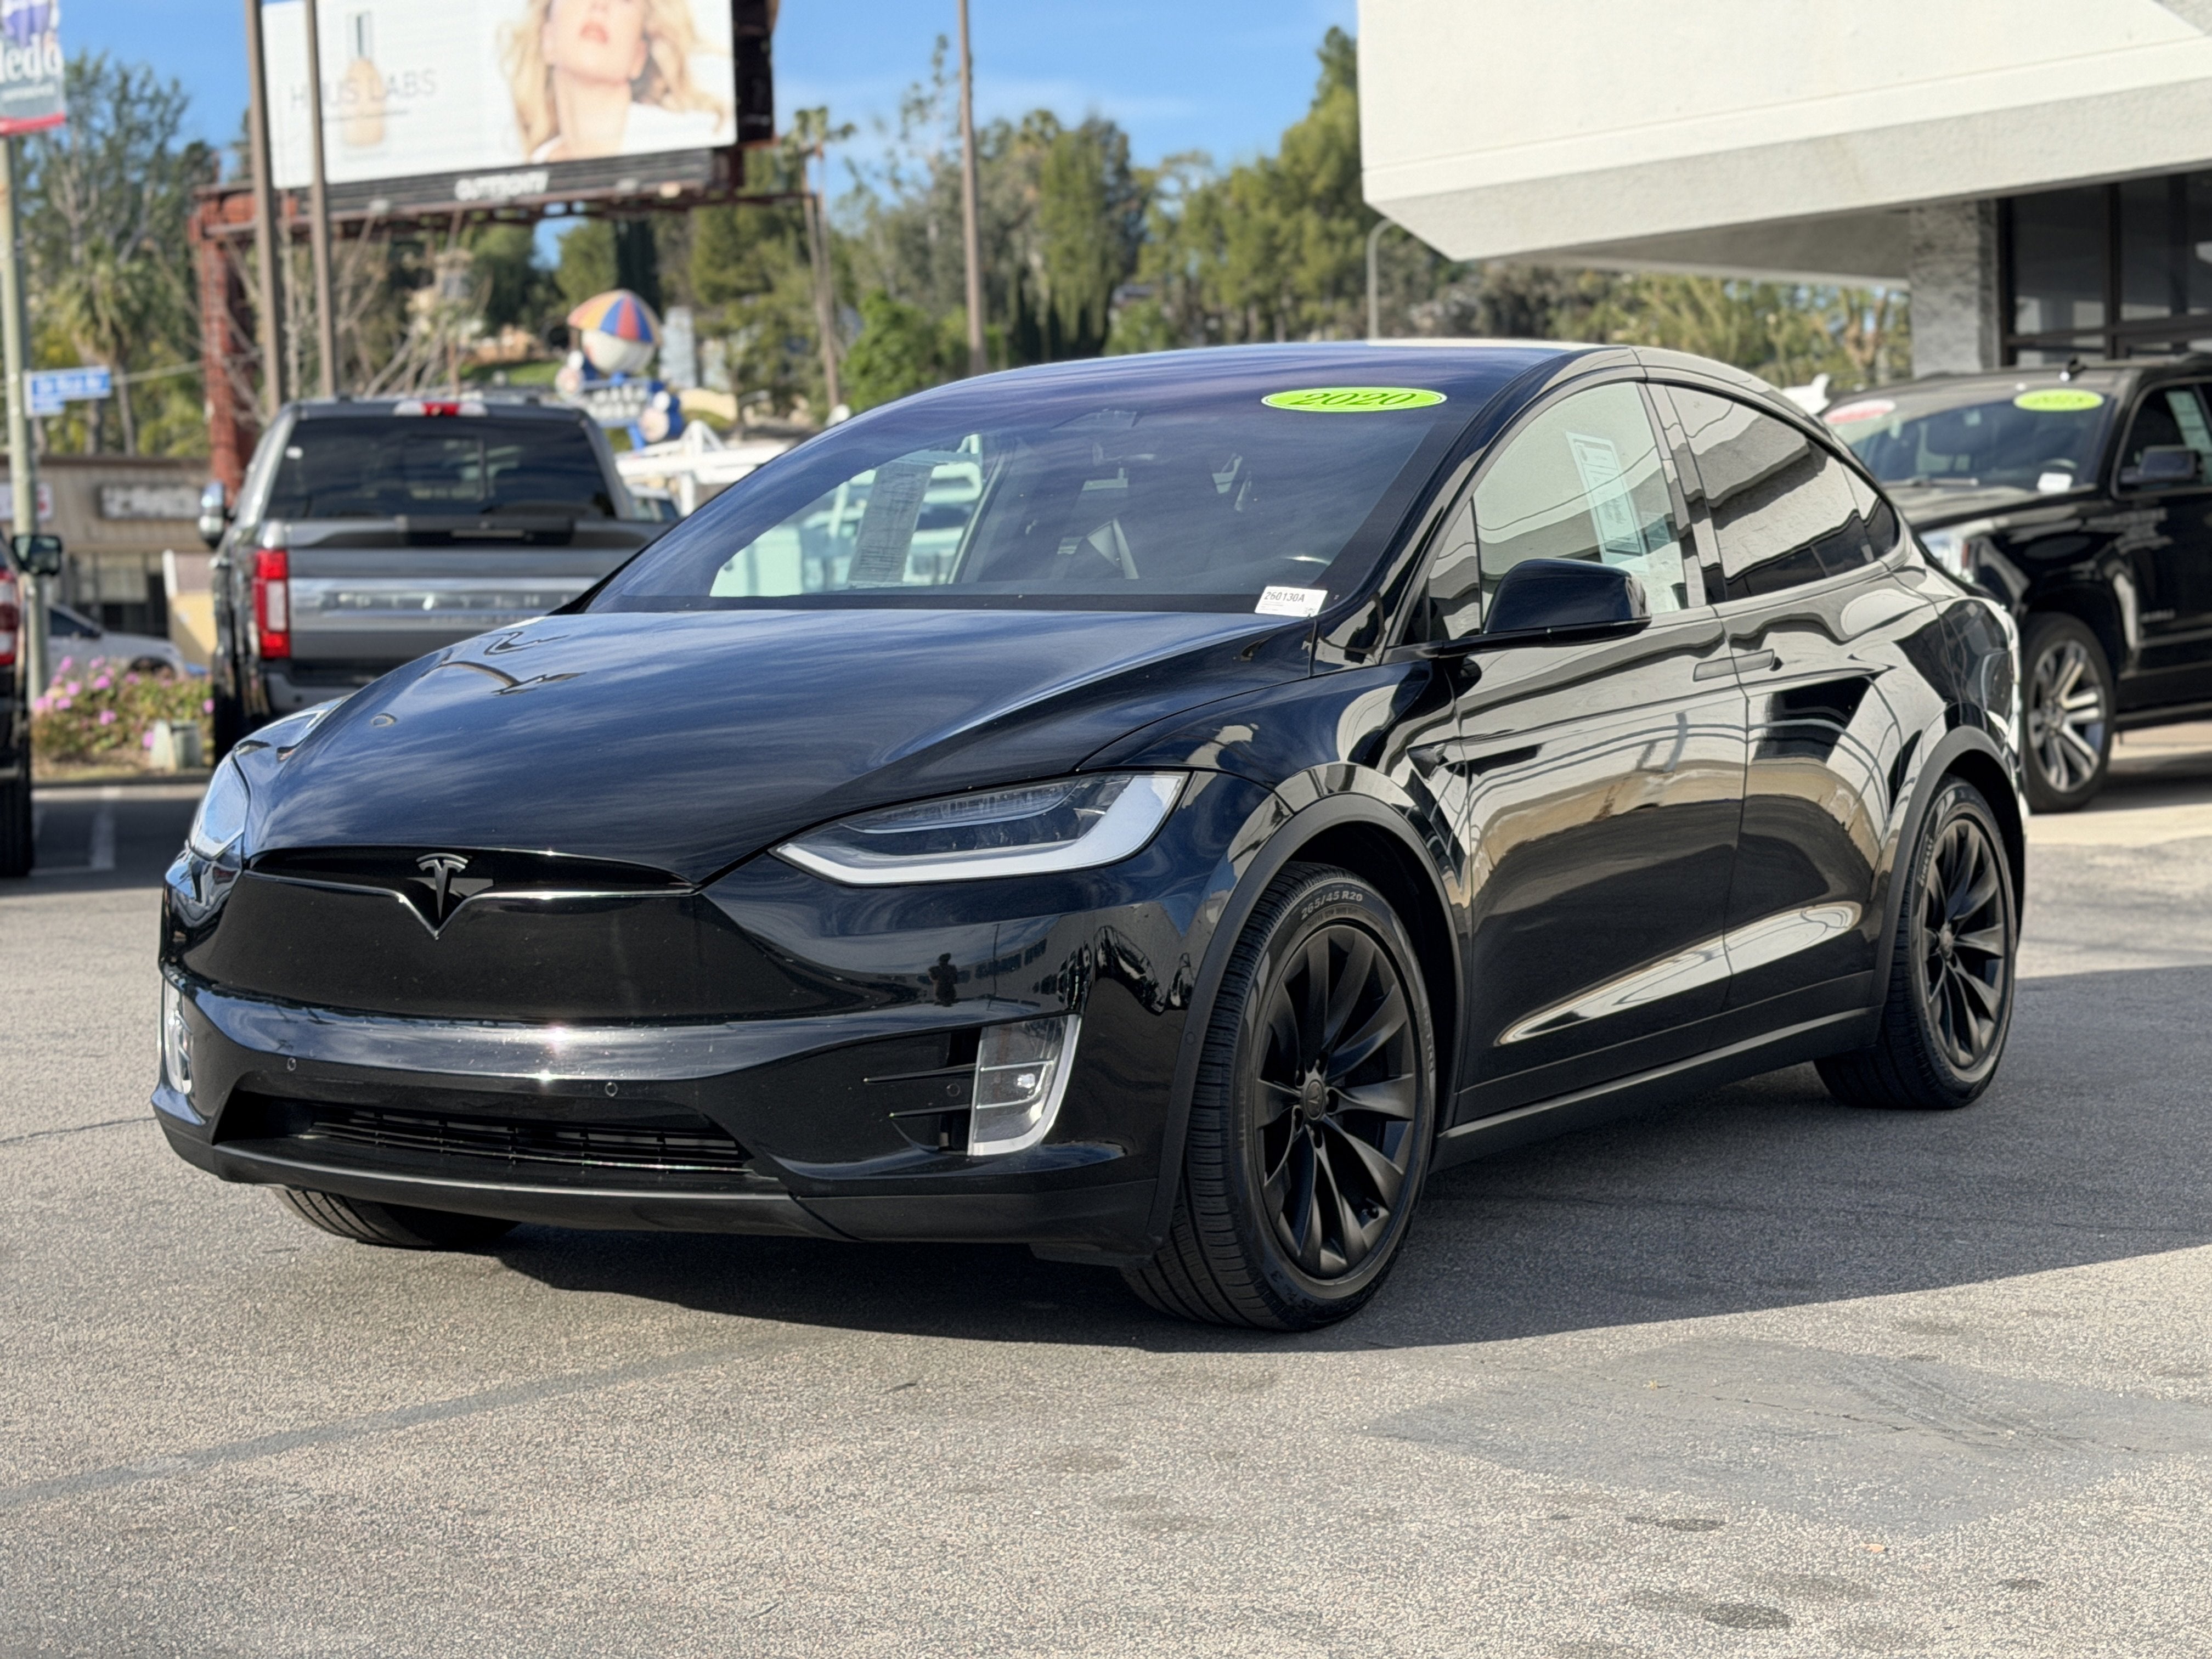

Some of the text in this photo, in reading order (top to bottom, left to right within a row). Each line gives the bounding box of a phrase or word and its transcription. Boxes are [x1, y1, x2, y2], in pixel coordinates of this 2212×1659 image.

[290, 77, 359, 109] HUS
[1288, 393, 1417, 405] 2020
[1264, 591, 1305, 602] 260130A
[1301, 890, 1363, 920] 265/45 R20
